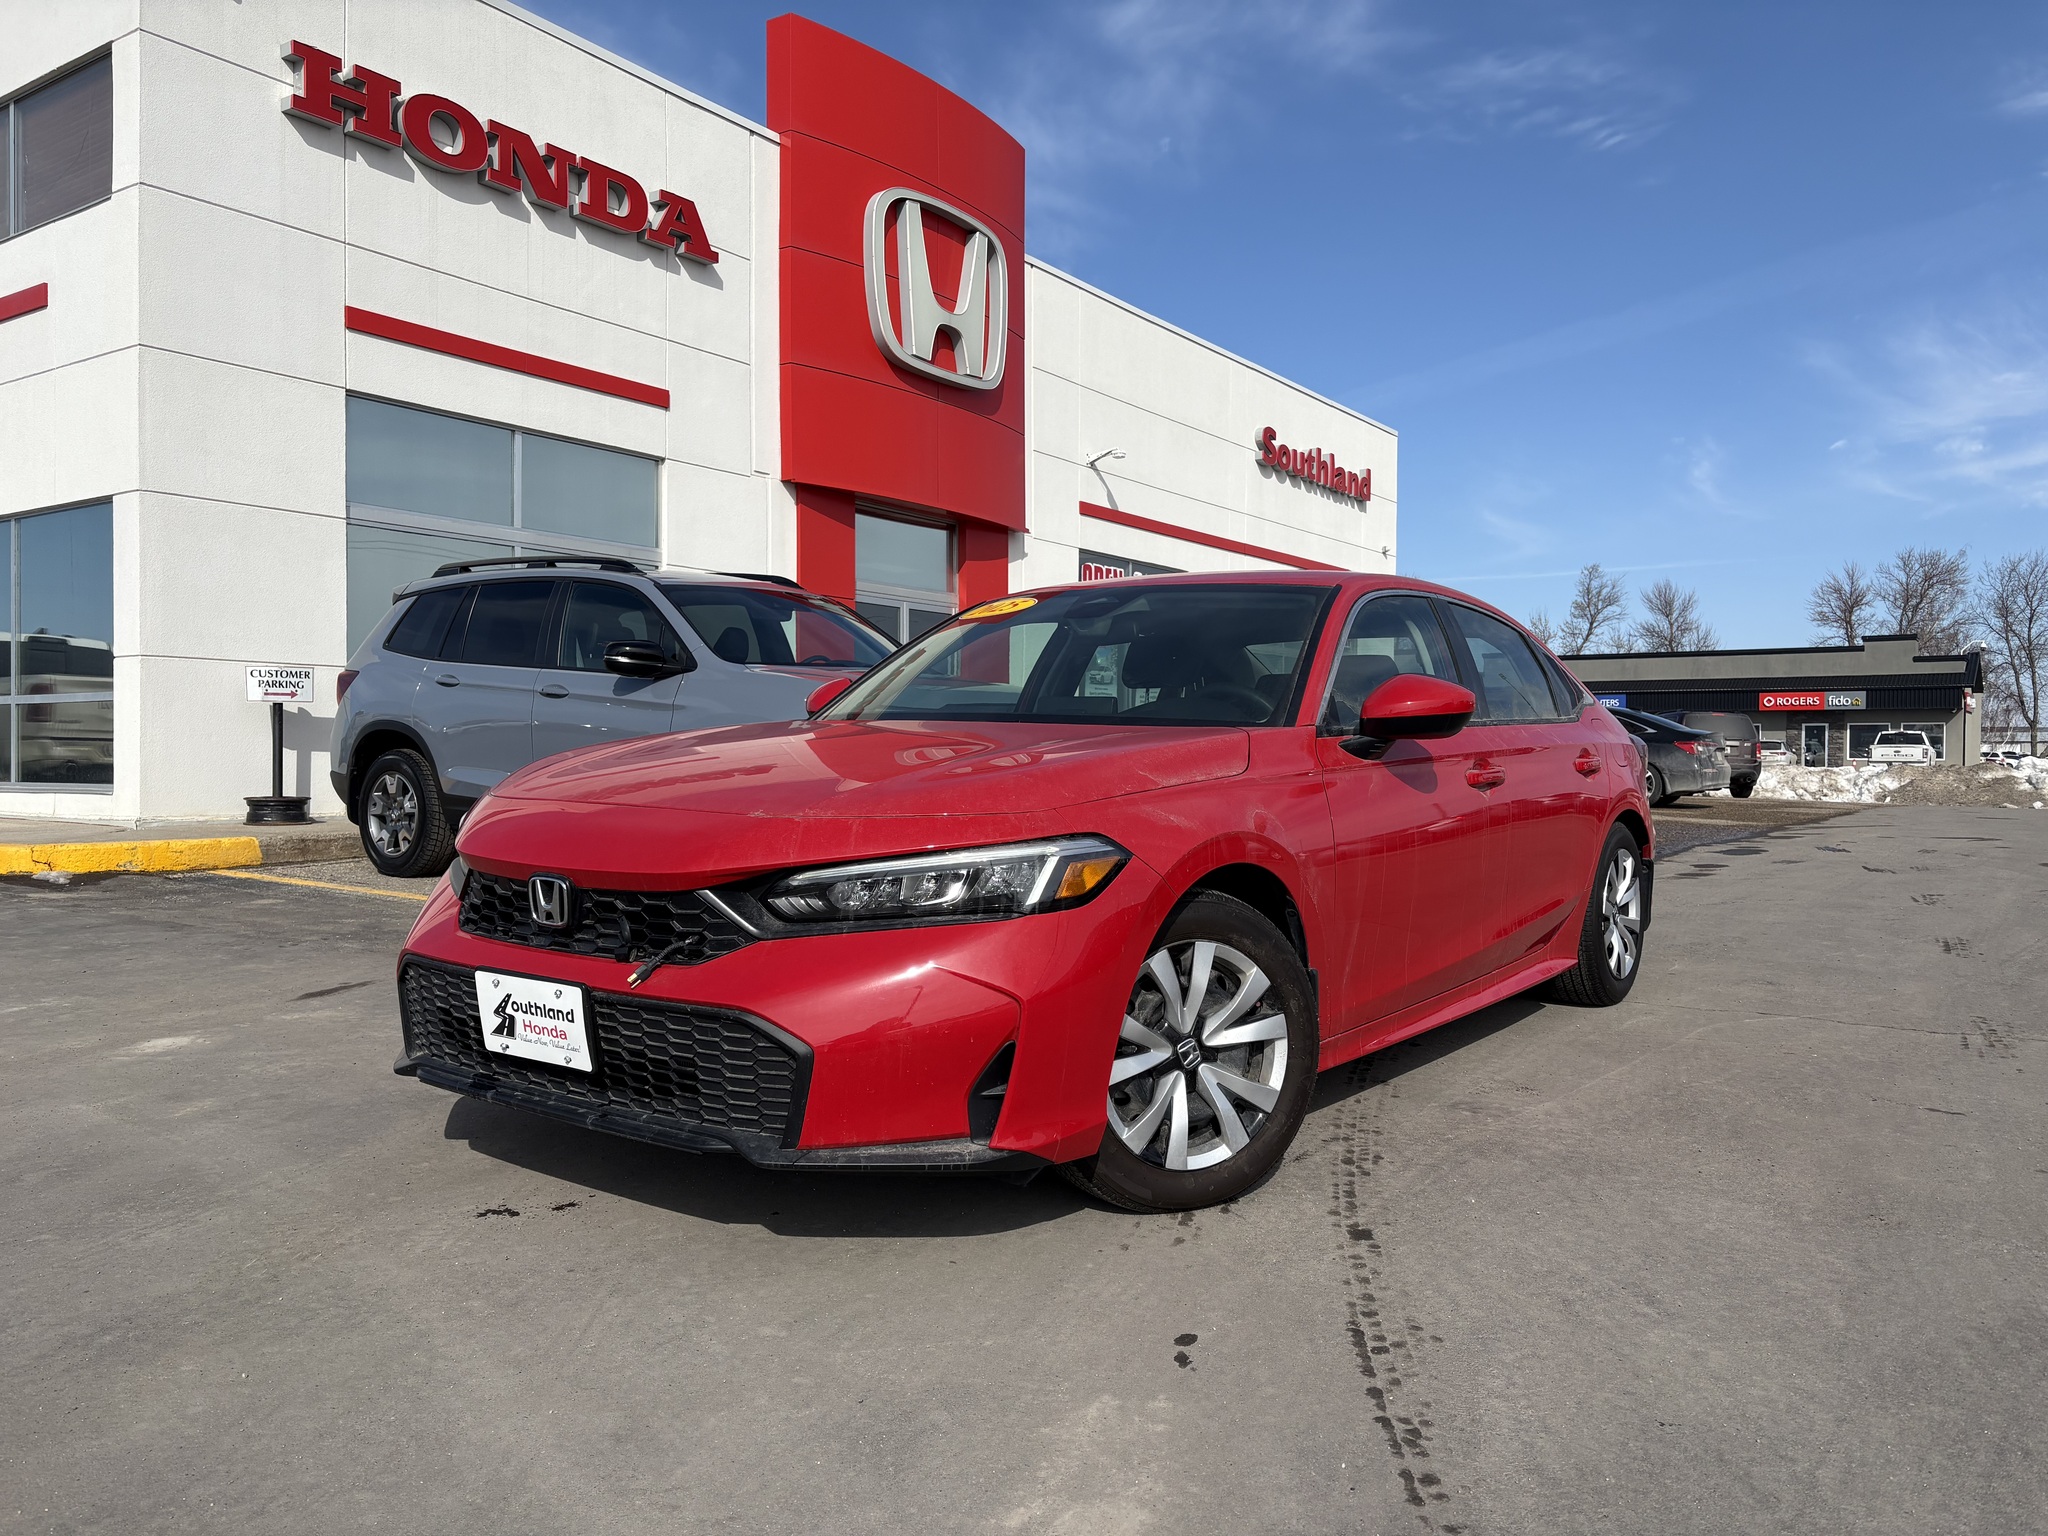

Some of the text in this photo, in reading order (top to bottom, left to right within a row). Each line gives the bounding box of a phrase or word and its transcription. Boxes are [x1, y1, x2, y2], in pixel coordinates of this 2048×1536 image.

[283, 39, 719, 265] HONDA
[1257, 426, 1371, 501] Southland
[250, 669, 311, 679] CUSTOMER
[258, 680, 305, 689] PARKING
[1600, 699, 1620, 707] TERS
[1776, 696, 1820, 706] ROGERS
[1828, 695, 1851, 706] fido
[523, 1019, 568, 1041] Honda
